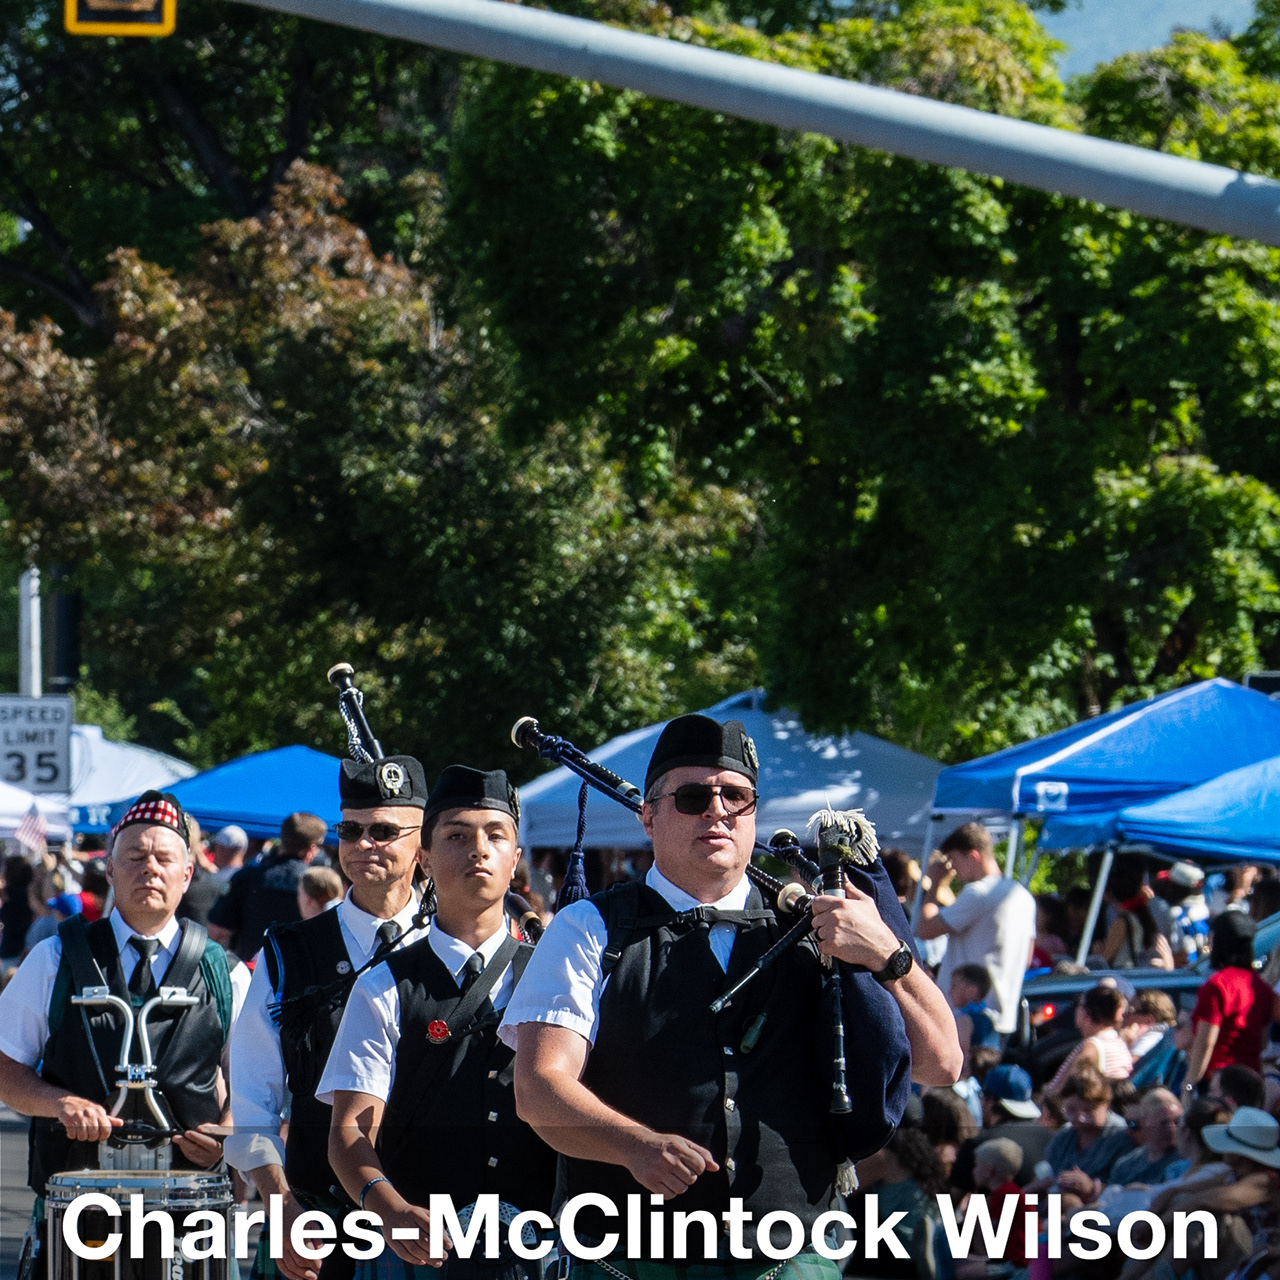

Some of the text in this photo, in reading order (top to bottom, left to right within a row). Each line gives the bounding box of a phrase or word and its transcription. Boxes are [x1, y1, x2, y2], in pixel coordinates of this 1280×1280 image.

[0, 706, 65, 724] SPEED
[3, 729, 56, 746] LIMIT
[3, 751, 60, 784] 35
